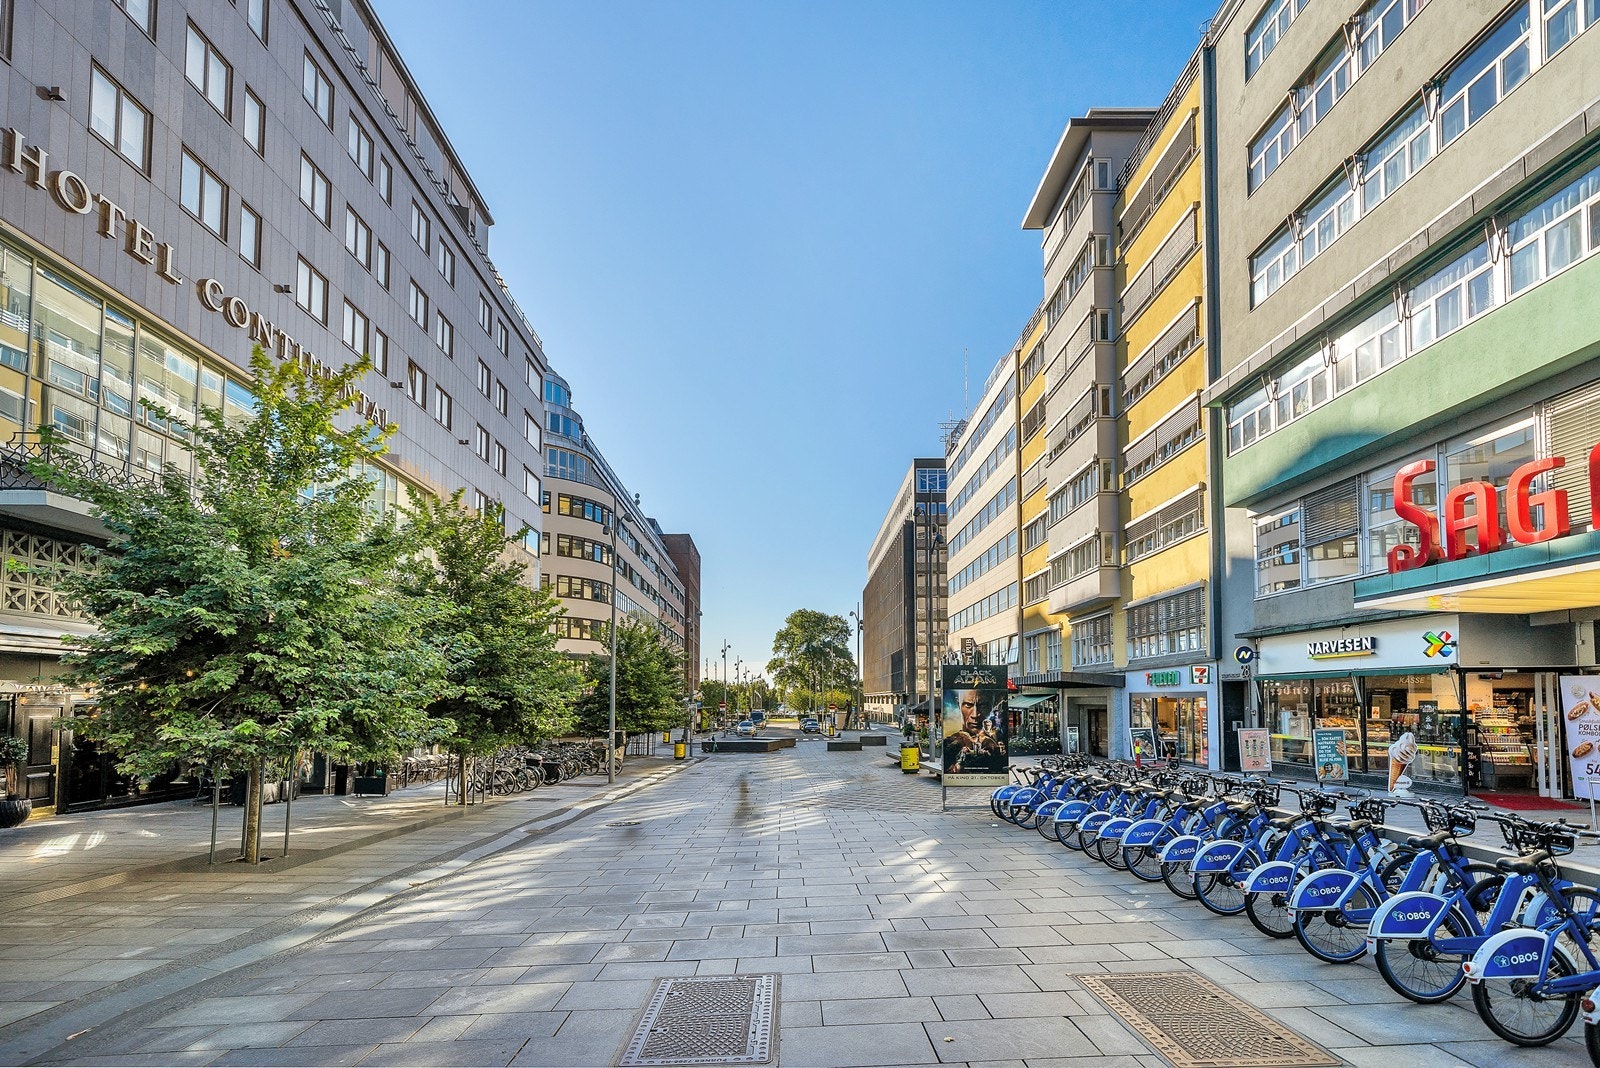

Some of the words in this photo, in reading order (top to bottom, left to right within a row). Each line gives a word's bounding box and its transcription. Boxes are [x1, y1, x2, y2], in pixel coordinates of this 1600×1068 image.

[3, 127, 183, 286] HOTEL
[1306, 637, 1373, 655] NARVESEN
[954, 675, 997, 684] ADAM
[1398, 676, 1425, 684] KASSE
[1269, 876, 1288, 884] OBOS
[1320, 886, 1341, 895] OBOS
[1406, 911, 1430, 920] OBOS
[1510, 952, 1538, 964] OBOS
